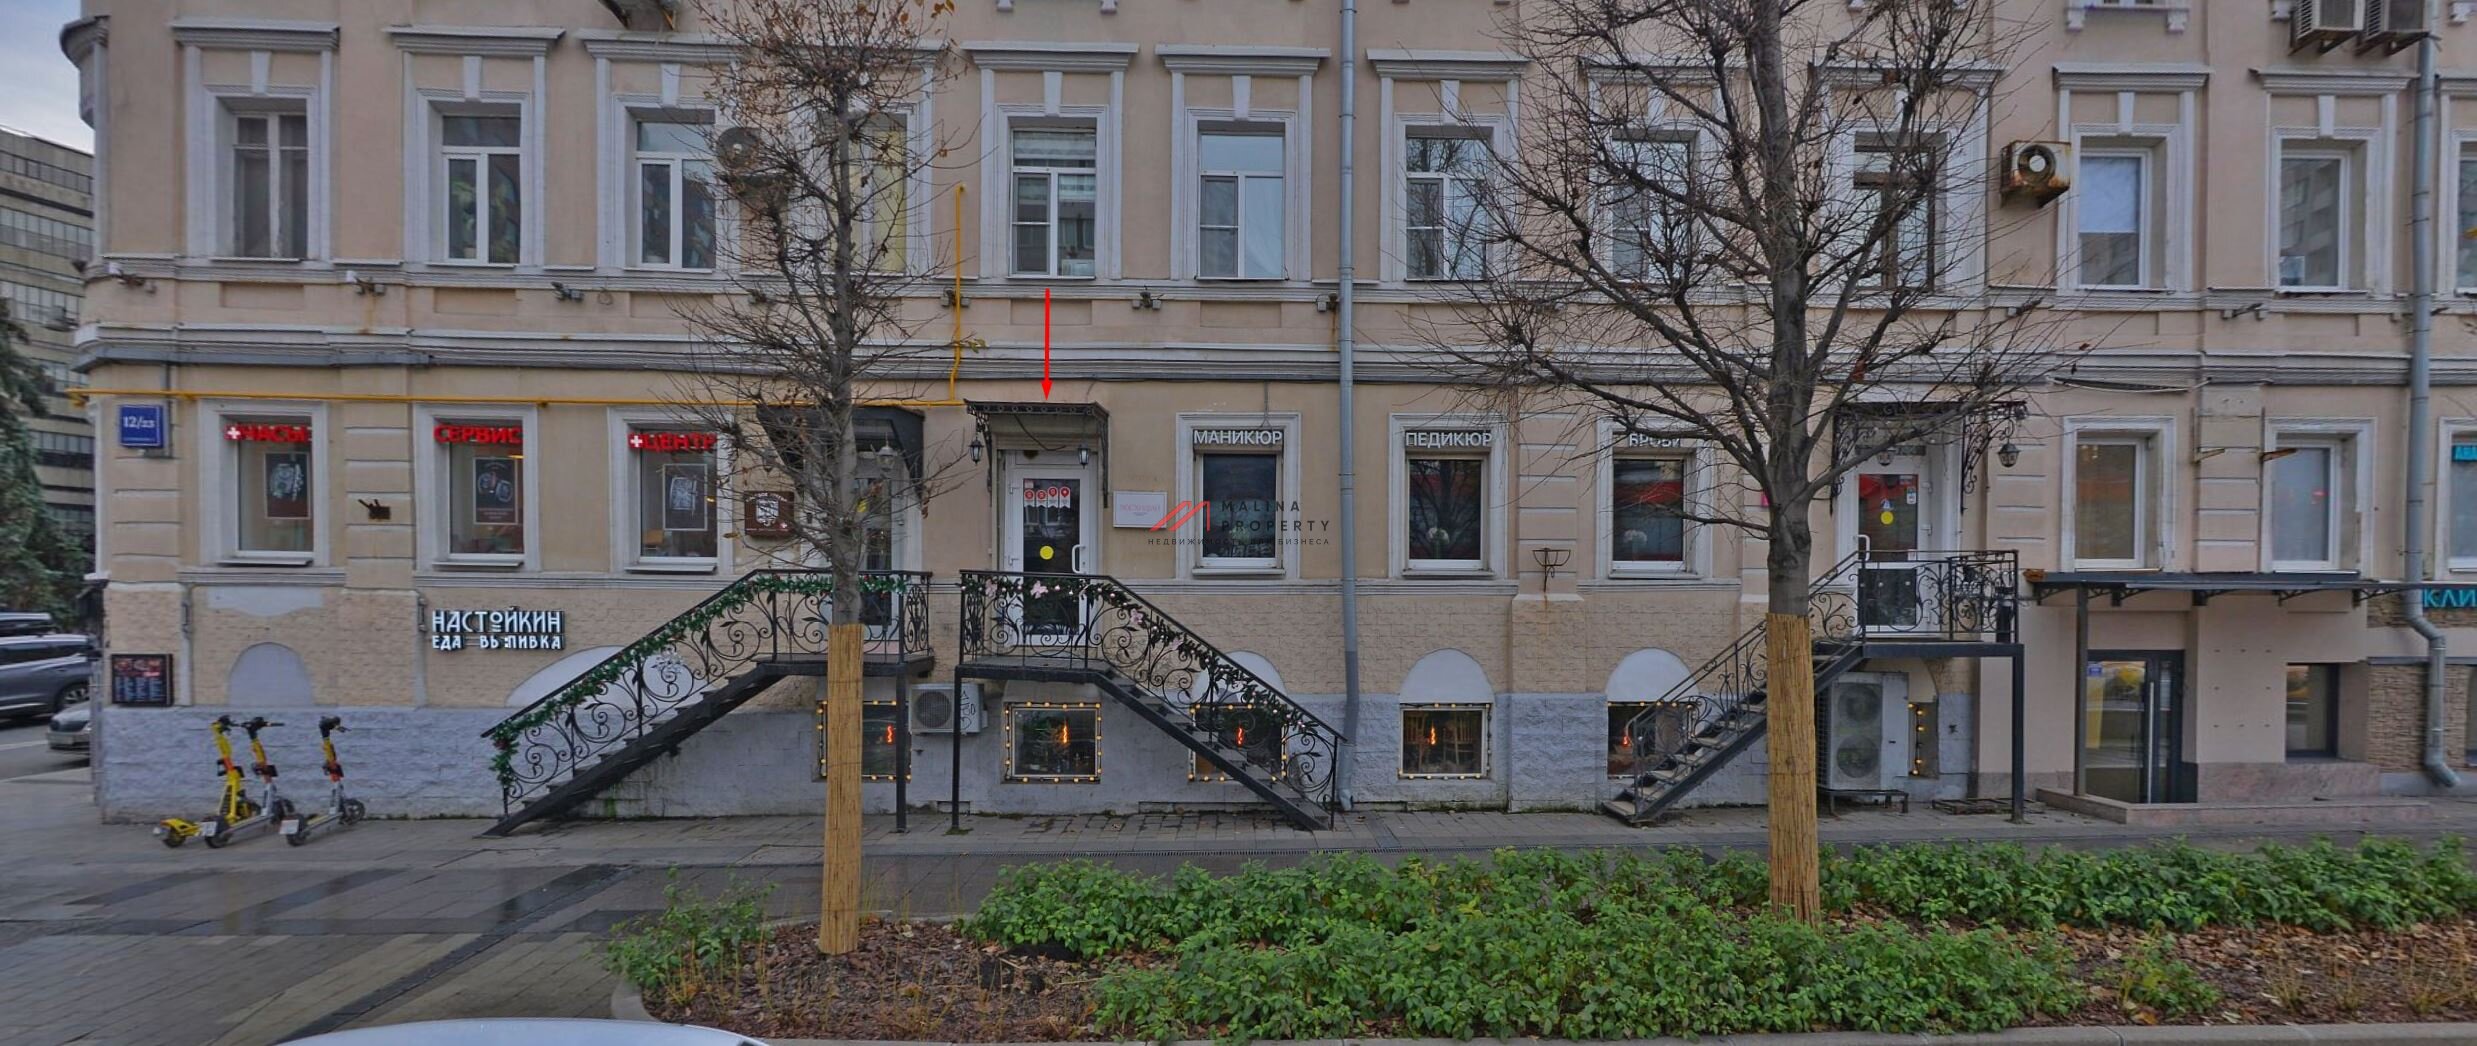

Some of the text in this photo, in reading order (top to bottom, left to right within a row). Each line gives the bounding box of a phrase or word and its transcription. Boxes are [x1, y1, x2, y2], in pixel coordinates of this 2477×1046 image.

[433, 424, 523, 443] СЕРВИС
[642, 432, 717, 452] ЦЕНТР
[1193, 430, 1283, 445] МАНИКЮР
[1405, 432, 1492, 448] ПЕДИКЮР
[432, 606, 562, 633] НАСТОЙКИН
[432, 635, 463, 650] ЕДА
